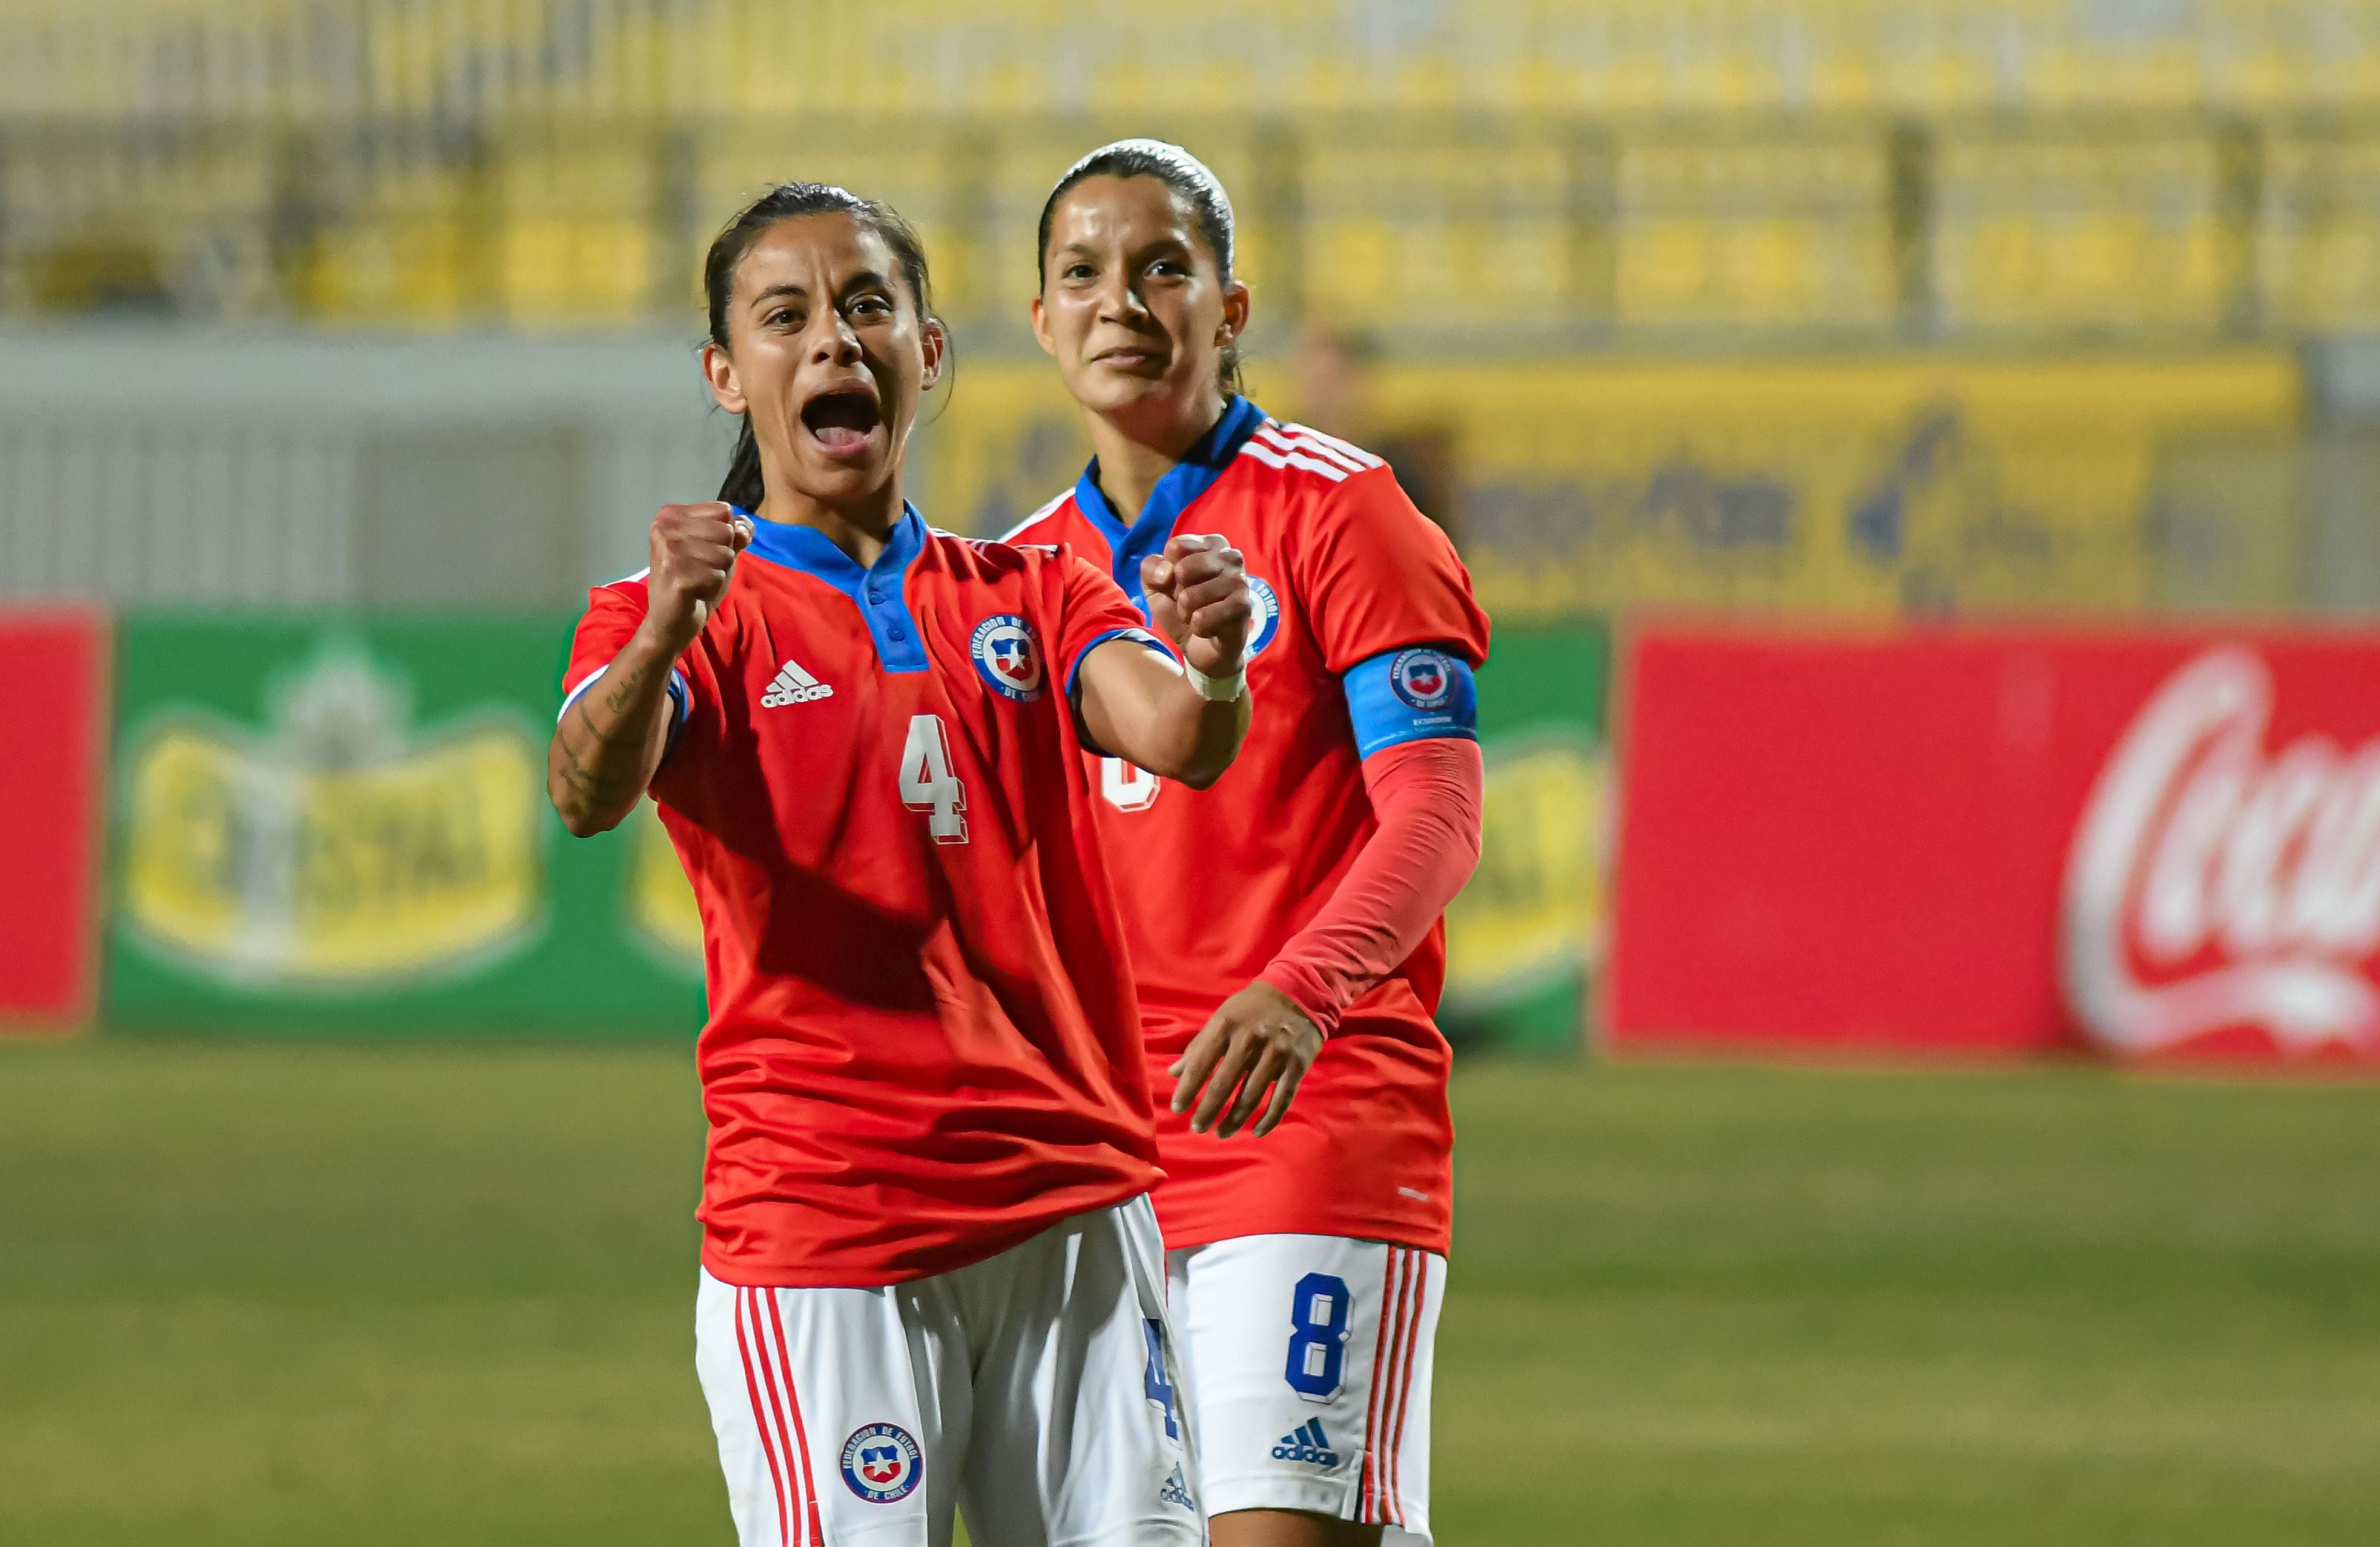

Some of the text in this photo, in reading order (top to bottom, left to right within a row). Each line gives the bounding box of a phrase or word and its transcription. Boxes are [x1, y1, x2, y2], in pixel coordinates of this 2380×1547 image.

[760, 684, 834, 708] adidas
[899, 714, 969, 845] 4
[1285, 1272, 1354, 1404] 8
[1142, 1318, 1181, 1448] 4
[843, 1427, 918, 1469] FEDERACION DE FUTBOL
[867, 1485, 908, 1500] DE CHILE
